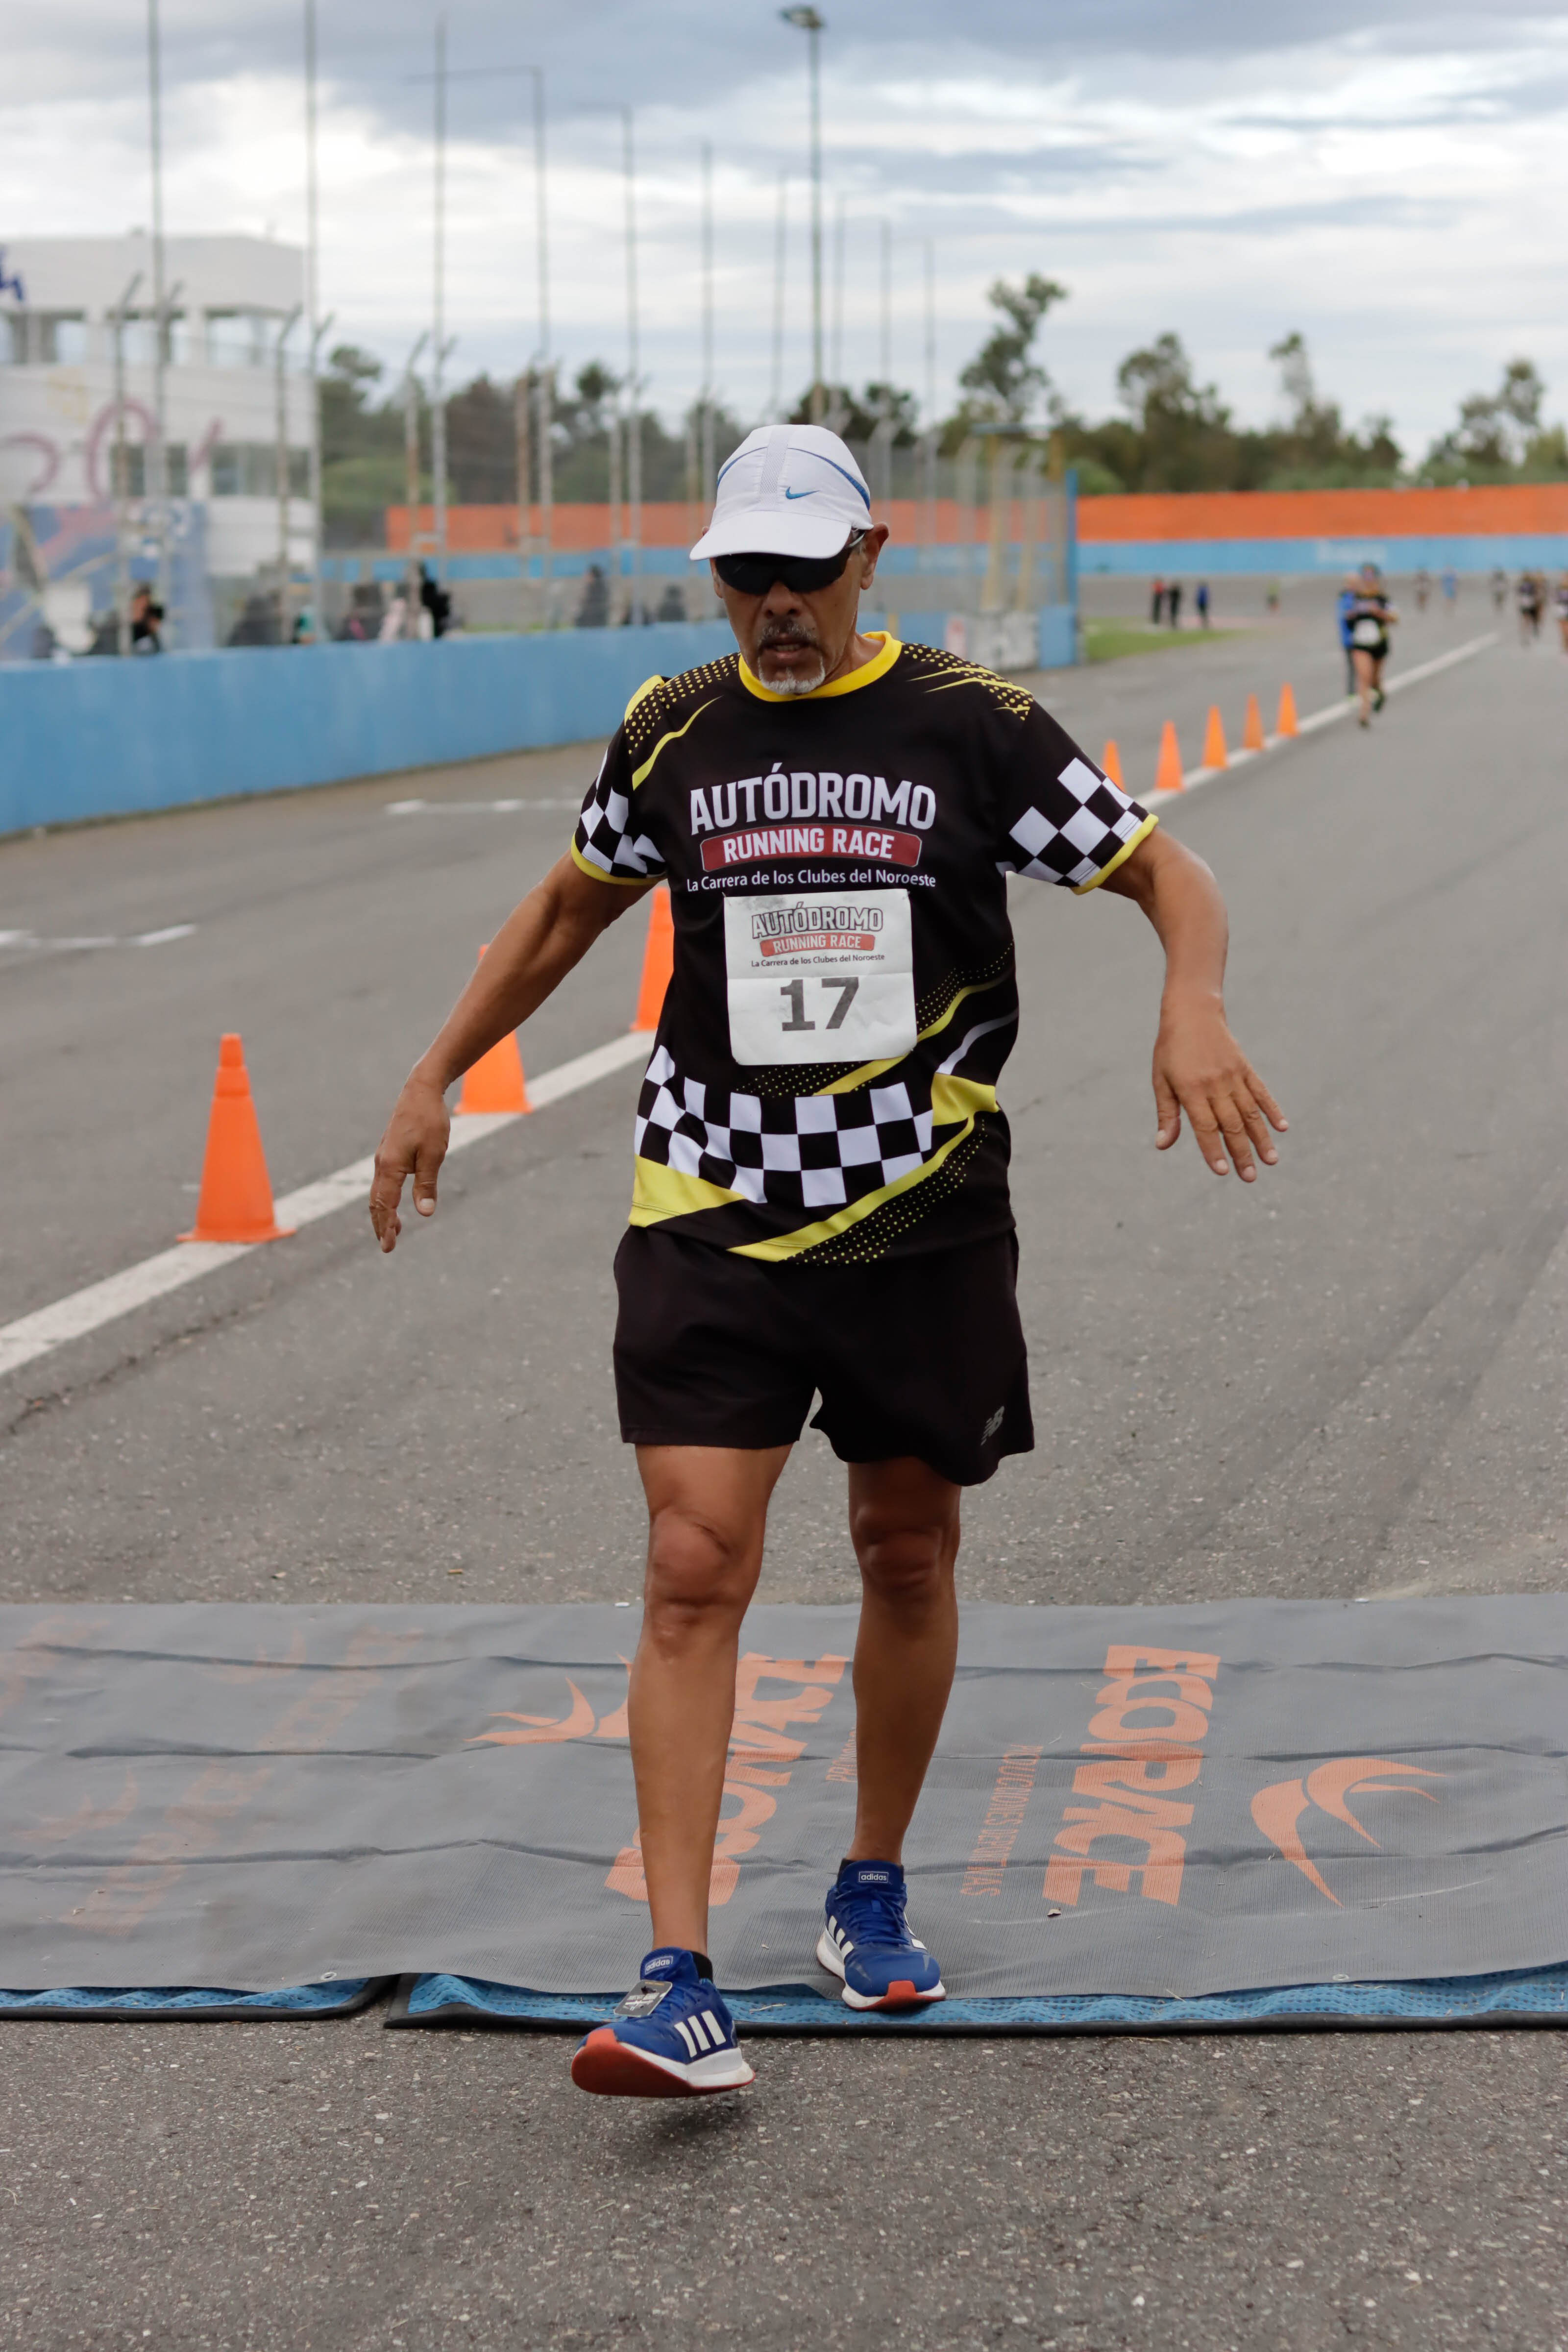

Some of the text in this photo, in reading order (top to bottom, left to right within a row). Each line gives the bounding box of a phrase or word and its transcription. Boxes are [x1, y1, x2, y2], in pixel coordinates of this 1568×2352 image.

[690, 762, 936, 835] AUTÓDROMO
[723, 828, 895, 863] RUNNING RACE
[687, 869, 935, 892] La Carrera de los Clubes del Noroeste
[752, 901, 883, 939] AUTÓDROMO
[761, 957, 787, 967] Carrera
[813, 955, 837, 963] Clubes
[839, 954, 851, 962] del
[852, 953, 885, 961] Noroeste
[772, 934, 861, 954] RUNNING RACE
[780, 976, 859, 1032] 17
[1042, 1645, 1221, 1906] ECORACE
[646, 1960, 671, 1971] adidas
